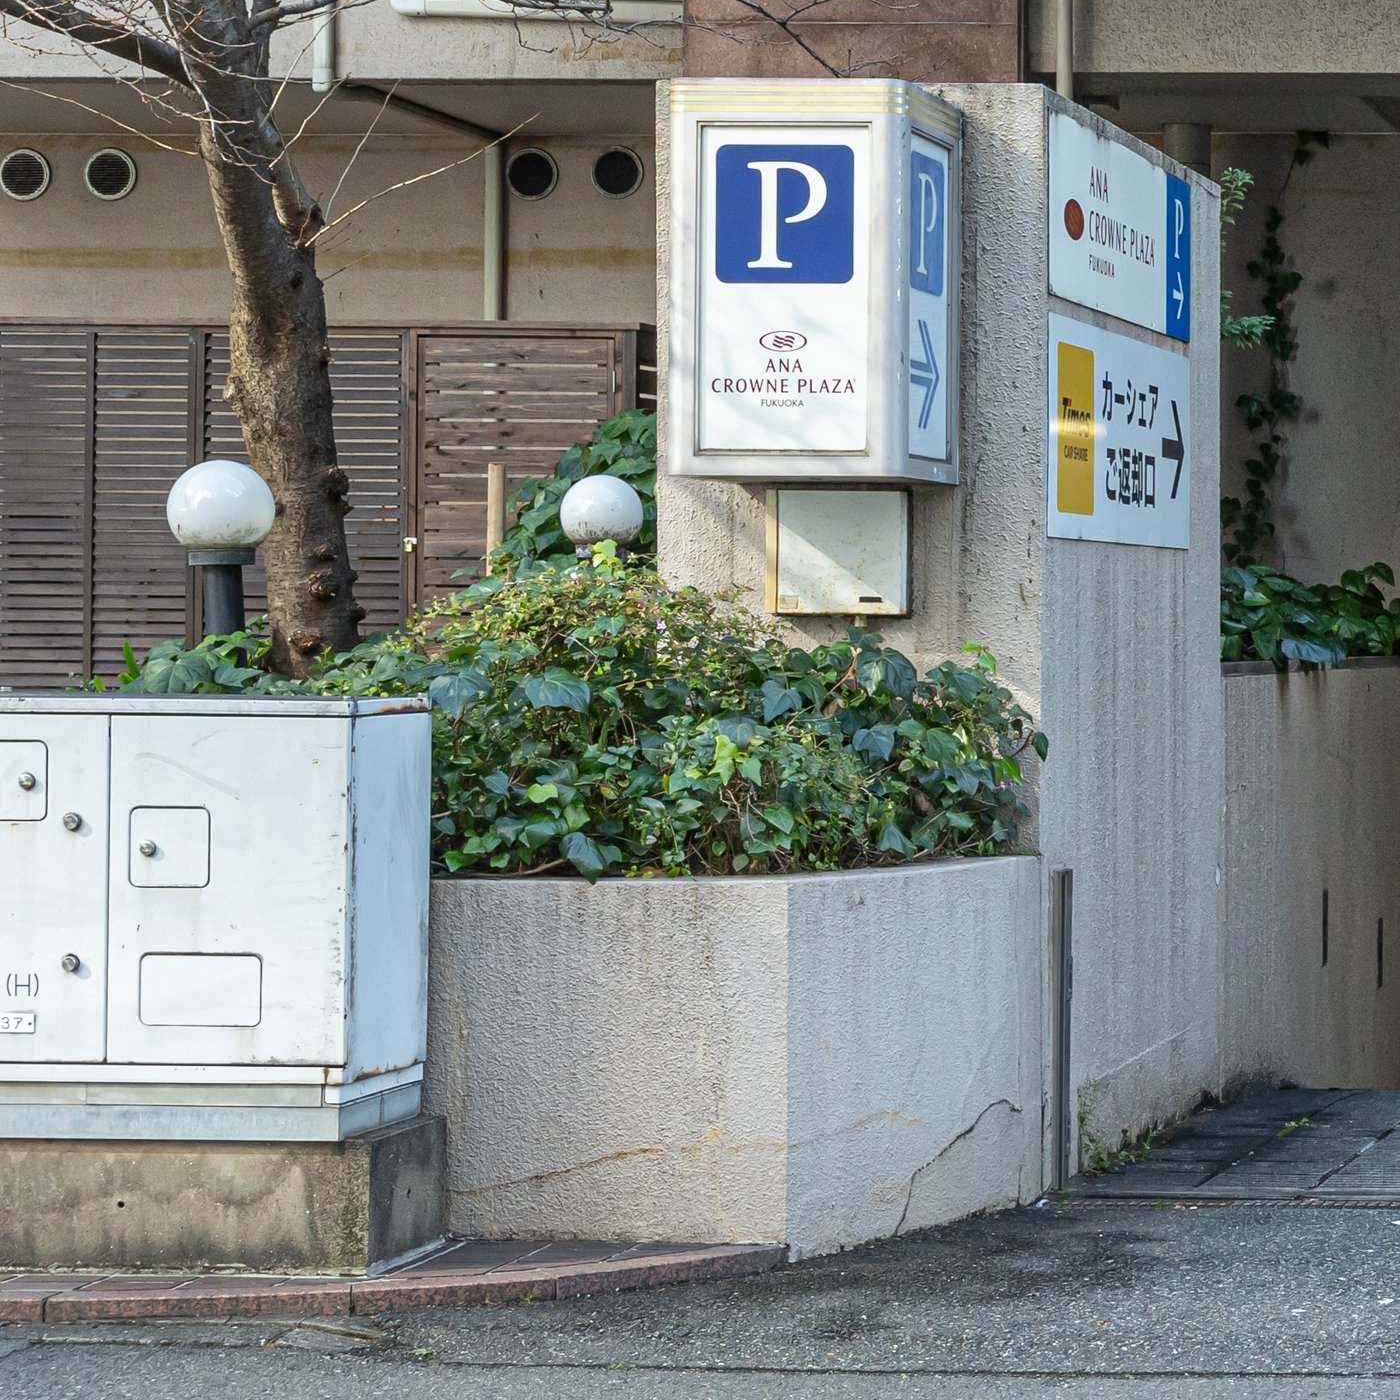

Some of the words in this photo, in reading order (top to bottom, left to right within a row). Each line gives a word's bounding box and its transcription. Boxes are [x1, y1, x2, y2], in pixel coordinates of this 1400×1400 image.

[1089, 166, 1109, 203] ANA
[746, 160, 828, 270] P
[917, 171, 938, 276] P
[1173, 198, 1184, 260] P
[1088, 210, 1127, 255] CROWNE
[1130, 228, 1155, 267] PLAZA
[1088, 254, 1115, 279] FUKUOKA
[765, 358, 803, 373] ANA
[711, 378, 789, 394] CROWNE
[797, 378, 855, 394] PLAZA
[760, 399, 805, 408] FUKUOKA
[1102, 371, 1159, 431] カーシェア
[1062, 397, 1091, 438] Times
[1064, 445, 1073, 460] CAR
[1074, 446, 1089, 462] SHARE
[1105, 447, 1156, 509] ご返却口
[6, 973, 39, 997] (H)
